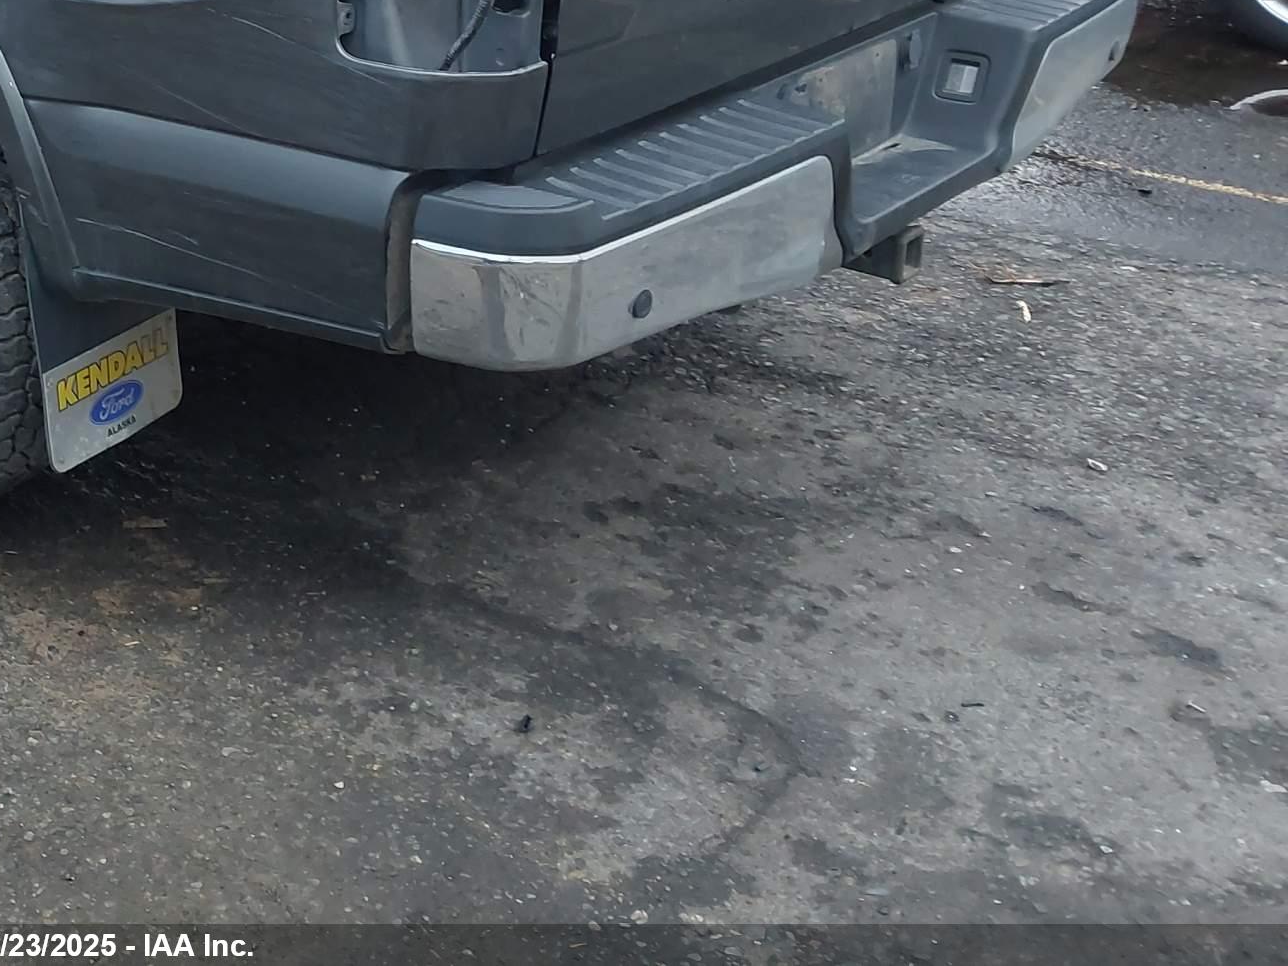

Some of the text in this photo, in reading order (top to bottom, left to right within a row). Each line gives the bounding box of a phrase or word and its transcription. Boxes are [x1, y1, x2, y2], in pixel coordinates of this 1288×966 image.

[57, 327, 168, 412] KENDALL
[99, 387, 135, 420] Ford
[107, 414, 137, 437] ALASKA
